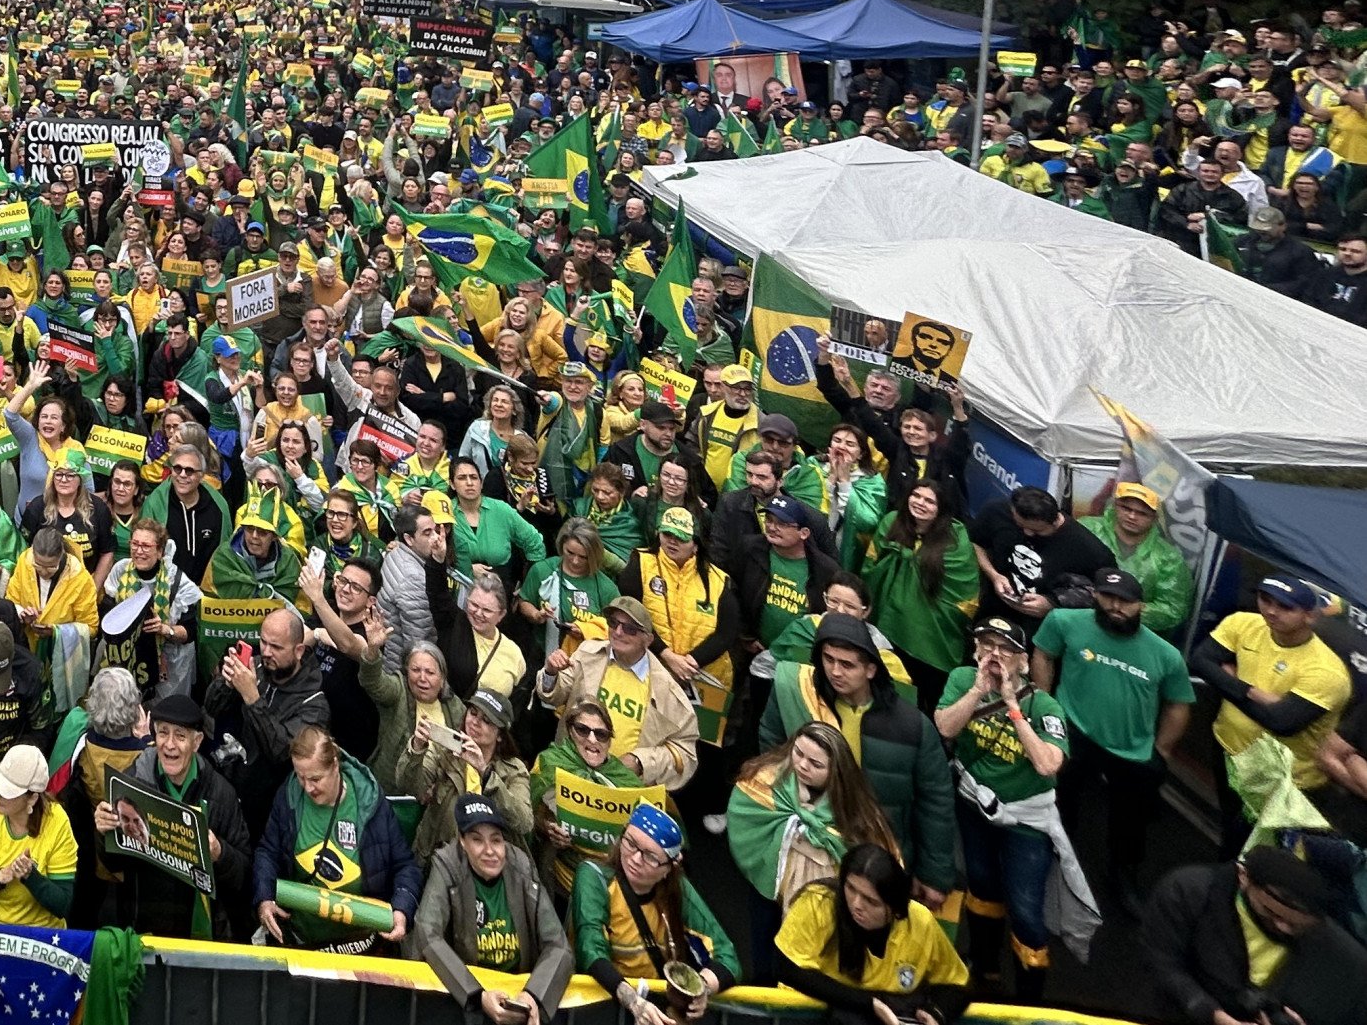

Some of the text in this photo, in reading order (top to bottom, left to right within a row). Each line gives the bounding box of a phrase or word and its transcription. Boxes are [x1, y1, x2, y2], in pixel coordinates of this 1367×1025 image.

[378, 6, 416, 15] MORAES
[418, 8, 430, 17] JÁ
[416, 21, 486, 37] IMPEACHMENT
[423, 32, 474, 45] DA CHAPA
[27, 121, 109, 143] CONGRESSO
[20, 223, 30, 233] JÁ
[240, 279, 267, 300] FORA
[234, 296, 274, 322] MORAES
[640, 364, 691, 393] BOLSONARO
[891, 361, 935, 381] FECHADO
[713, 430, 735, 443] BRAS
[204, 606, 278, 617] BOLSONAR
[597, 687, 644, 723] RASI
[147, 812, 195, 840] Nosso APOIO
[560, 820, 621, 845] ELEGÍV
[121, 835, 142, 852] JAIR
[151, 835, 198, 864] Presidente
[170, 832, 196, 851] melhor
[318, 888, 354, 925] já
[20, 938, 29, 951] E
